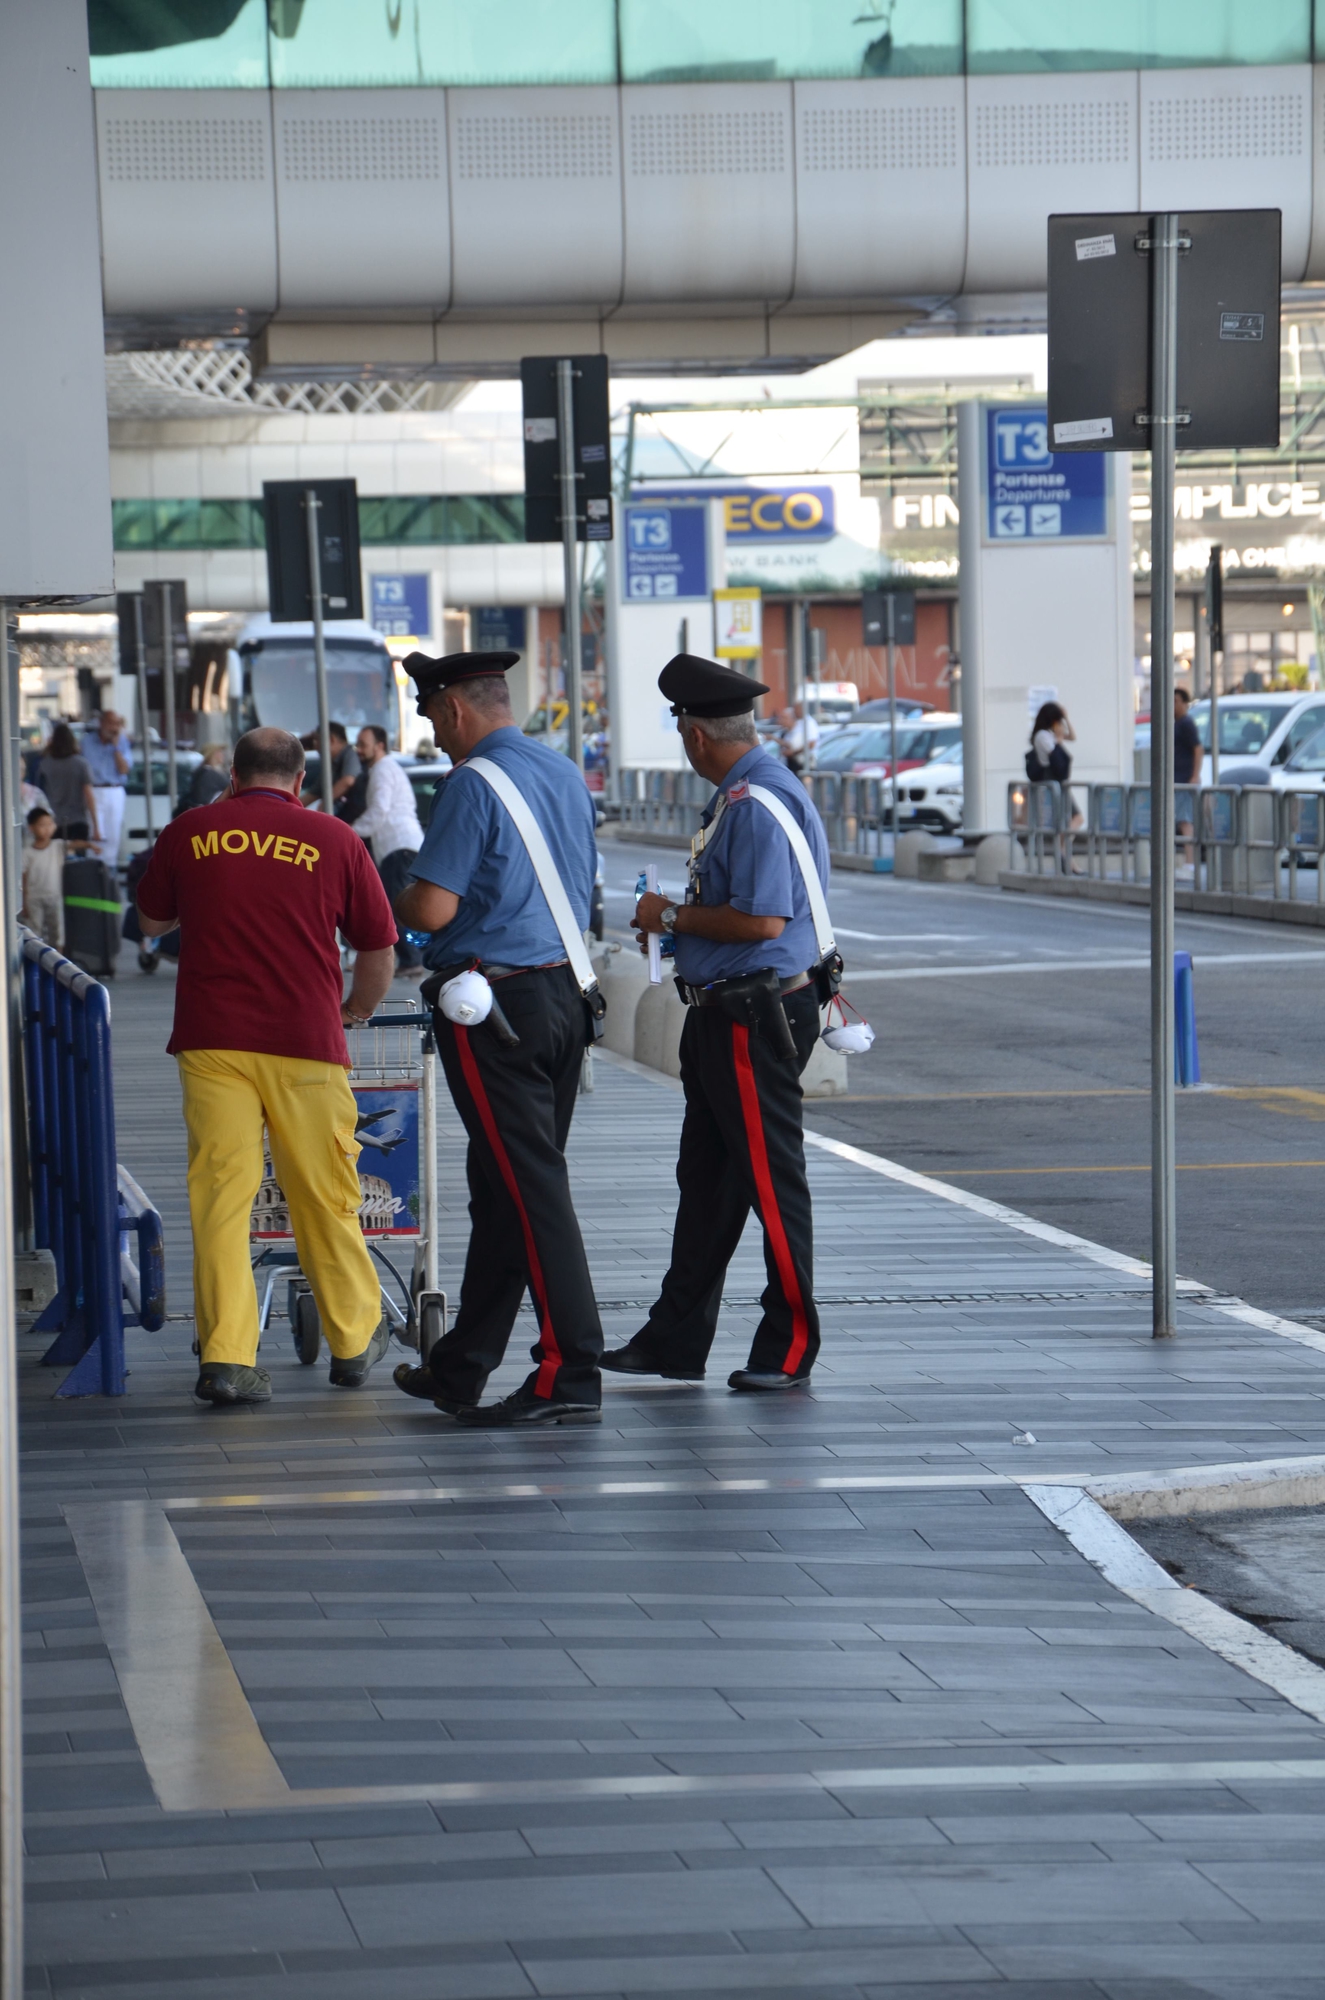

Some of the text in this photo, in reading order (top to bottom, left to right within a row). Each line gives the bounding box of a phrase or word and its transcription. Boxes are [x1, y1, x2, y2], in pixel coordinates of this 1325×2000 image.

[998, 422, 1048, 462] T3
[995, 473, 1067, 488] Partenze
[996, 488, 1071, 504] Departures
[630, 517, 670, 545] T3
[756, 554, 819, 566] BANK
[375, 580, 404, 600] T3
[191, 829, 321, 872] MOVER
